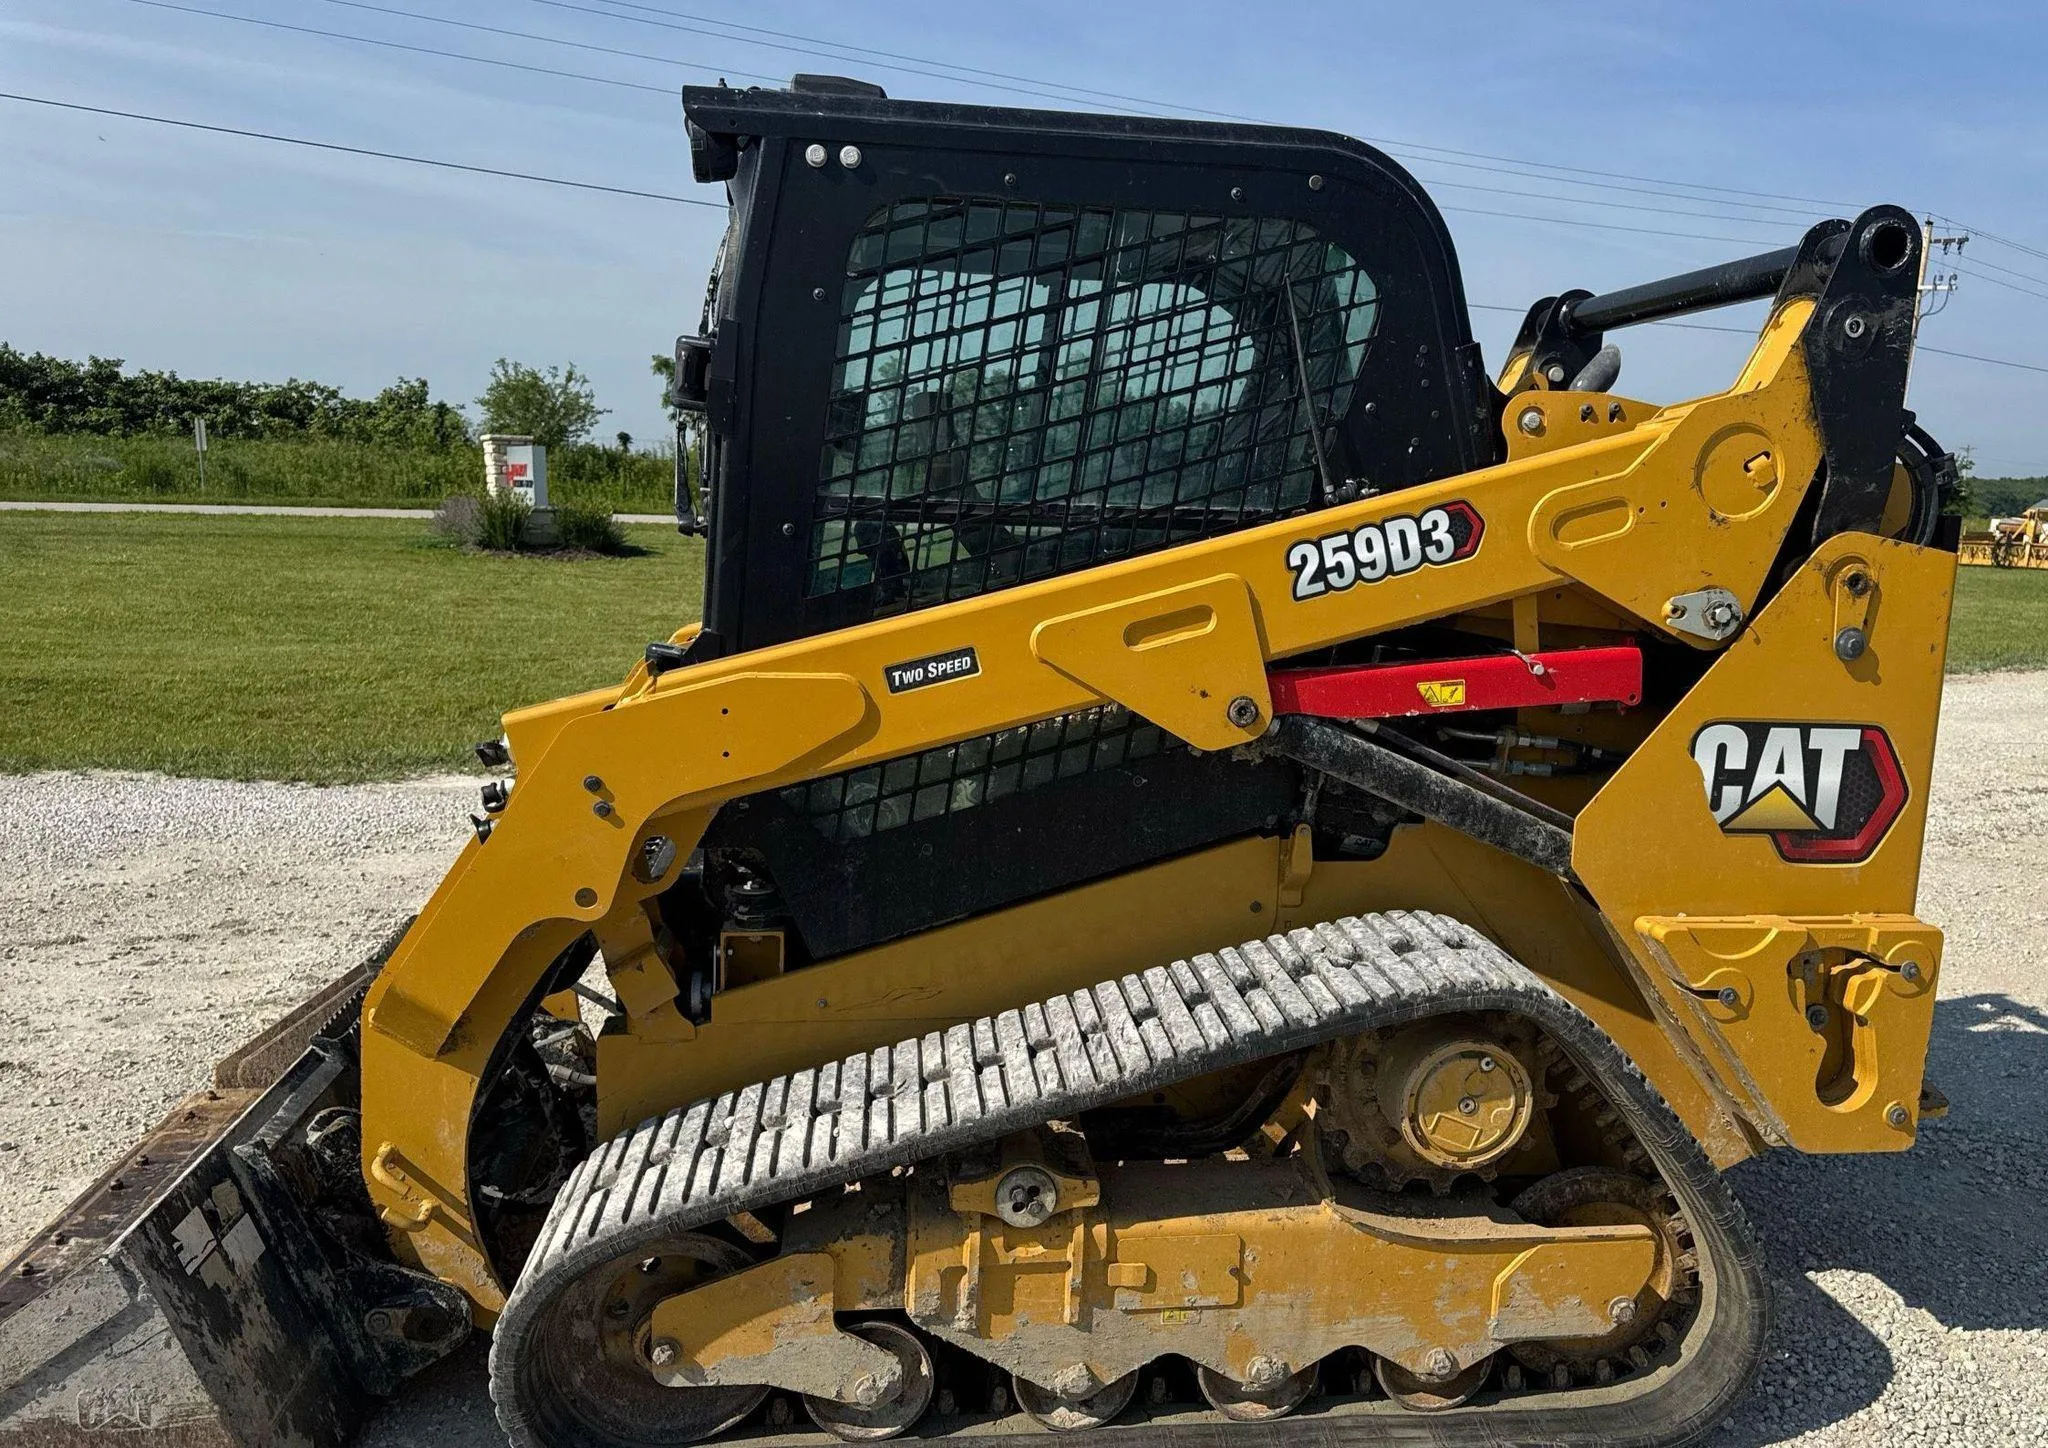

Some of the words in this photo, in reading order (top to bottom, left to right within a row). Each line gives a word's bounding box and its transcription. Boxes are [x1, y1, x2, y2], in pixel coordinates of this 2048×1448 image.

[1289, 509, 1455, 598] 259D3
[892, 668, 924, 686] TWO
[928, 657, 971, 678] SPEED
[1695, 724, 1862, 830] CAT
